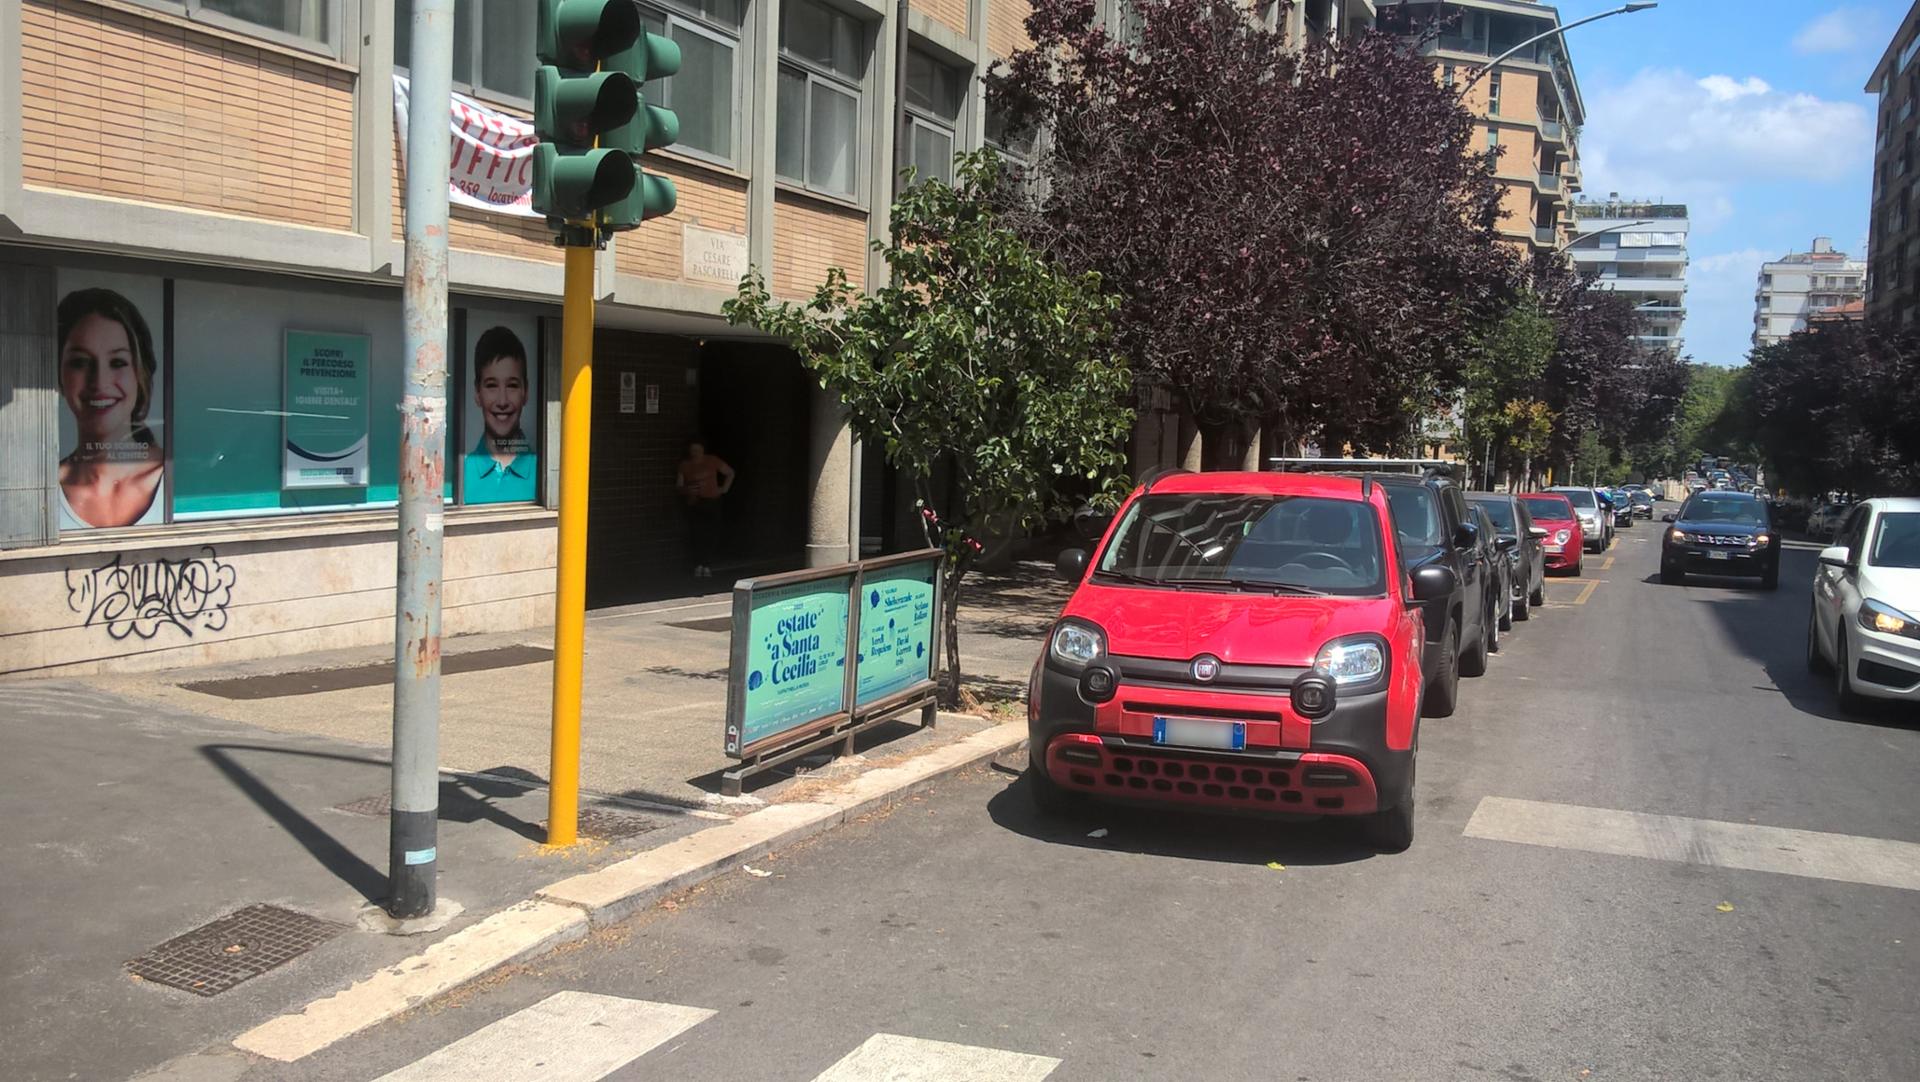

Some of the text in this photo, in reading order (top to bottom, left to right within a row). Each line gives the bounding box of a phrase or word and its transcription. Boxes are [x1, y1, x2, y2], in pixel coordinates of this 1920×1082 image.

[711, 238, 725, 250] VIA
[703, 251, 731, 266] CESARE
[693, 263, 739, 281] PASCARELLA
[95, 442, 112, 450] TUO
[777, 611, 818, 636] estate
[771, 632, 820, 661] a Santa
[772, 652, 817, 685] Cecilia
[1198, 664, 1213, 676] FIAT
